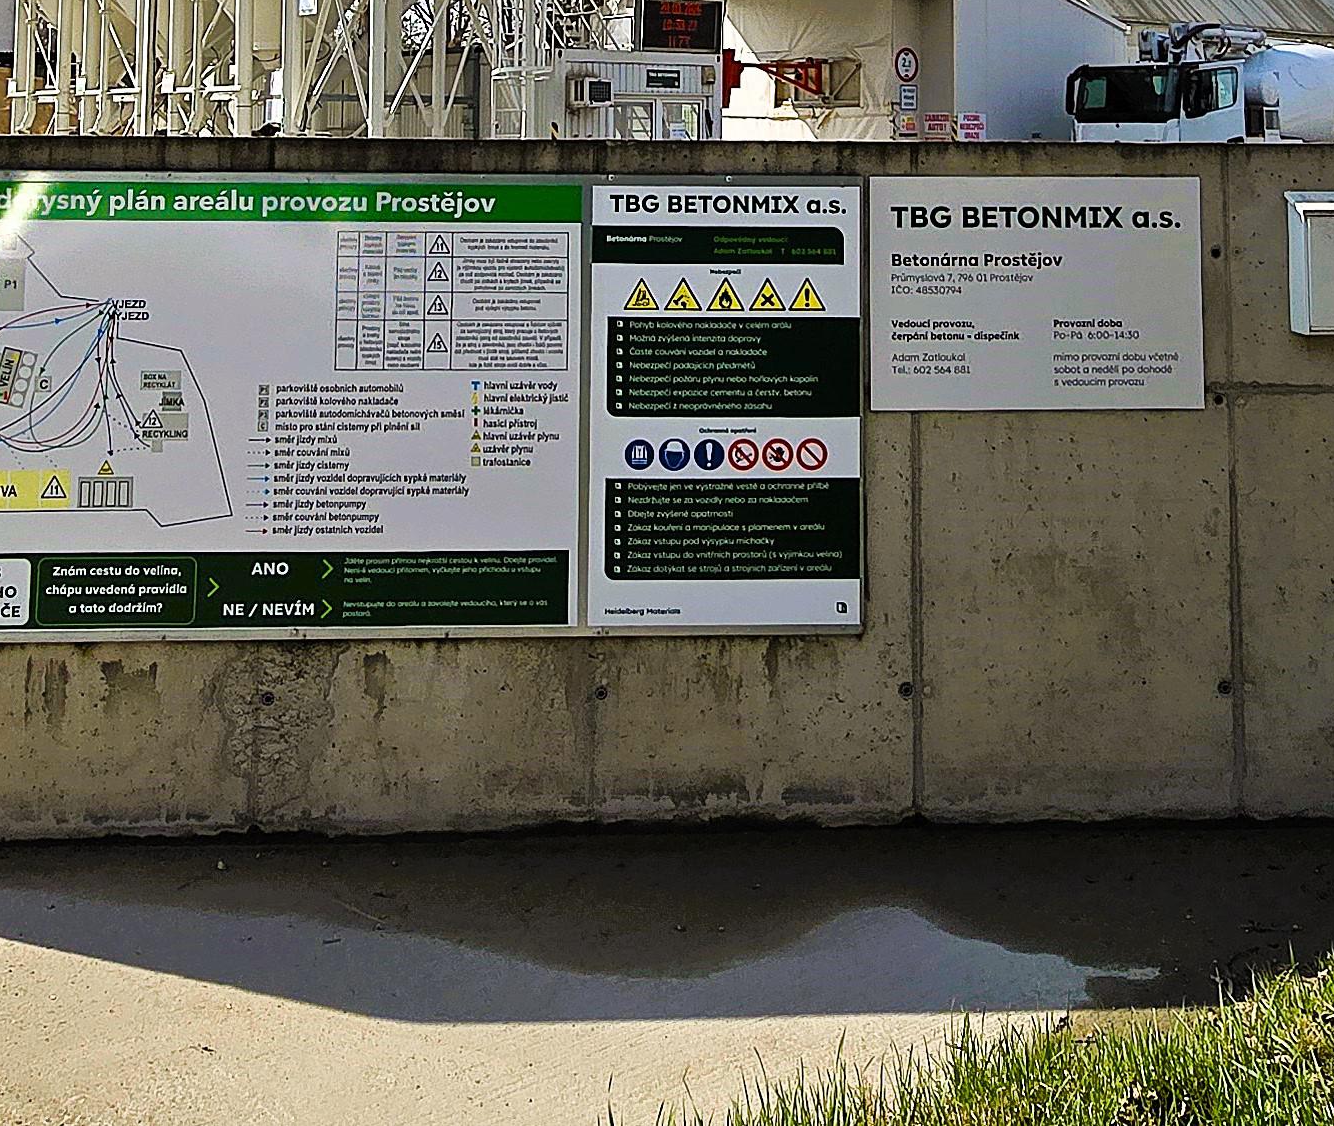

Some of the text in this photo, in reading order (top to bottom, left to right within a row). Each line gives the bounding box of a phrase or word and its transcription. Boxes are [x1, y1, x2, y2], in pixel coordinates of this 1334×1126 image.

[109, 189, 166, 216] plán
[173, 189, 253, 211] areálu
[262, 196, 367, 217] provozu
[376, 191, 496, 218] Prostějov
[610, 195, 846, 214] TBG BETONMIX a.s.
[891, 206, 1181, 228] TBG BETONMIX a.s.
[892, 251, 1063, 270] Betonárna Prostějov
[4, 280, 17, 289] P1
[112, 300, 146, 308] VJEZD
[891, 319, 977, 330] Vedoucí provozu,
[1053, 319, 1122, 327] Provozní doba
[892, 331, 928, 342] čerpání
[930, 331, 964, 340] betonu
[972, 331, 1019, 342] dispečink
[892, 353, 965, 362] Adam Zatloukal
[892, 365, 970, 374] Tel.: 602 564 881
[39, 379, 49, 390] C
[142, 430, 188, 438] RECYKLING
[53, 564, 182, 578] Znám cestu do velína,
[252, 562, 288, 575] ANO
[46, 582, 187, 597] chápu uvedená pravidla
[80, 604, 105, 613] tato
[108, 602, 163, 613] dodržím?
[223, 600, 314, 617] NE / NEVÍM
